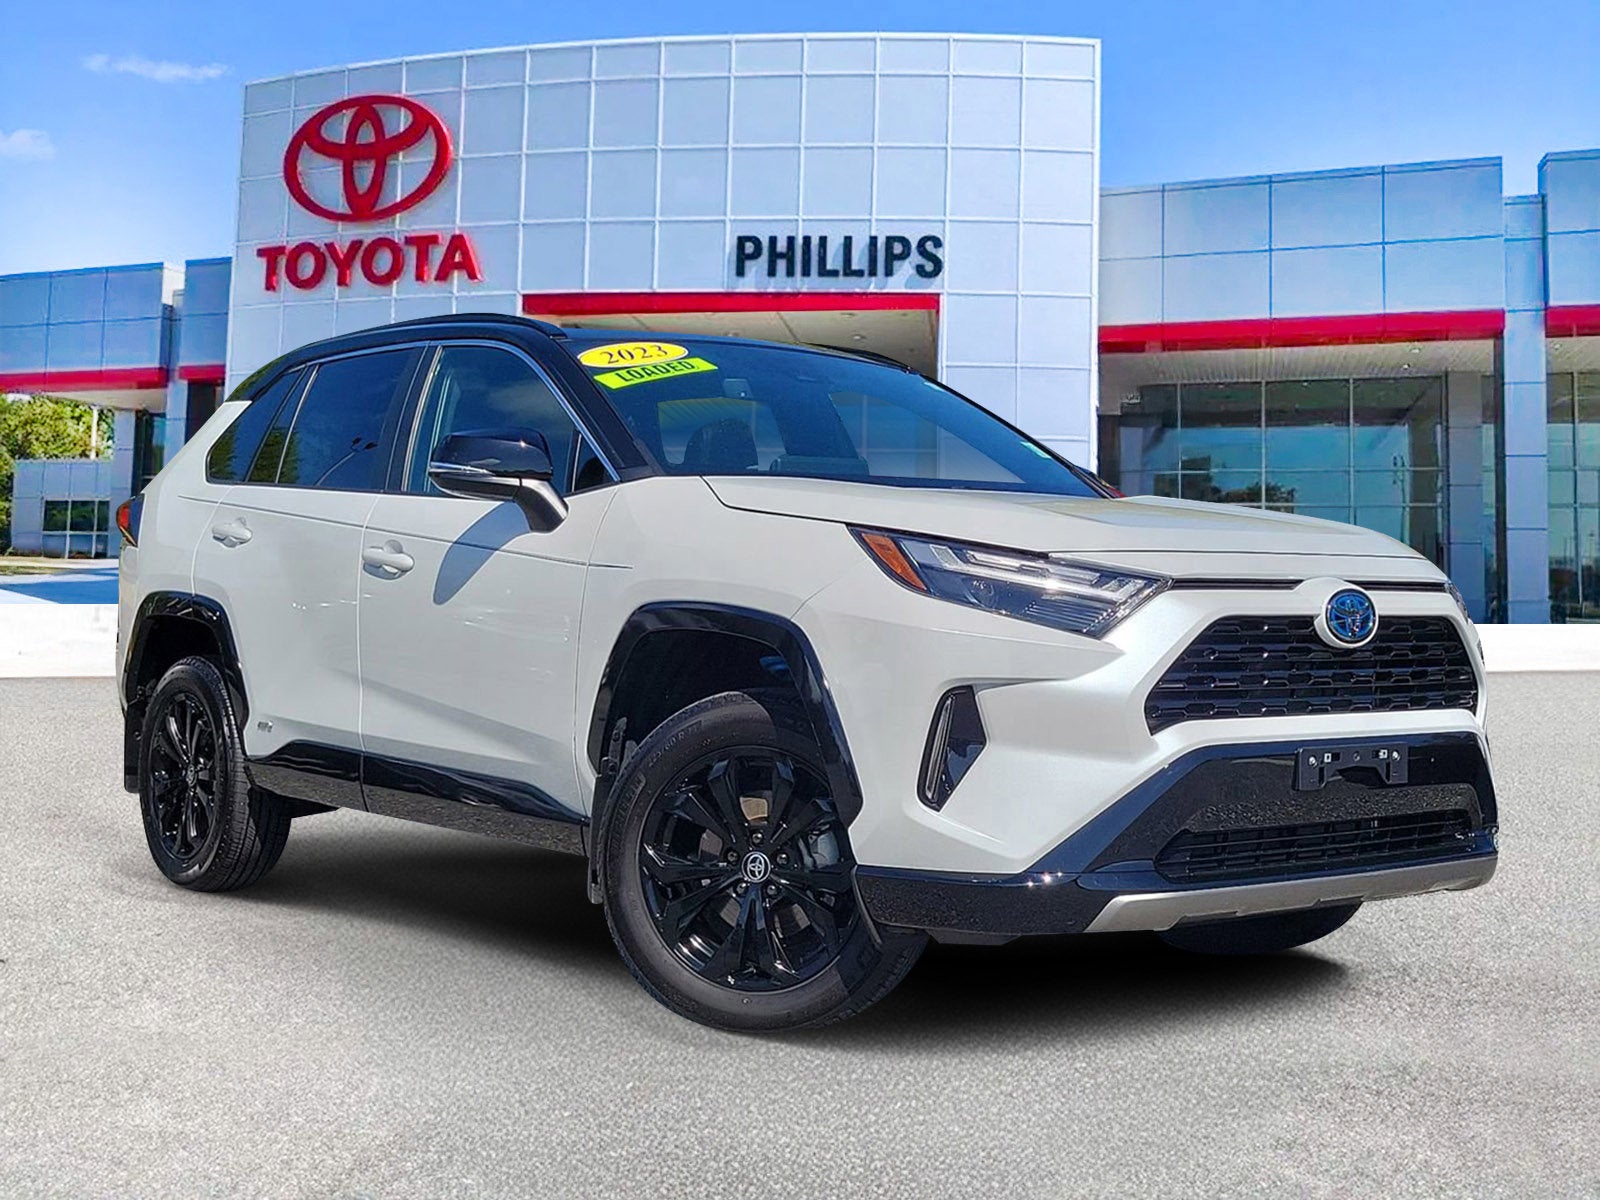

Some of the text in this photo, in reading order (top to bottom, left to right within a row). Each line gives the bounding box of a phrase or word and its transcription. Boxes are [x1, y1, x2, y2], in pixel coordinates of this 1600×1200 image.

[256, 234, 482, 291] TOYOTA
[735, 235, 944, 278] PHILLIPS
[600, 344, 669, 365] 2023
[615, 361, 696, 382] LOADED
